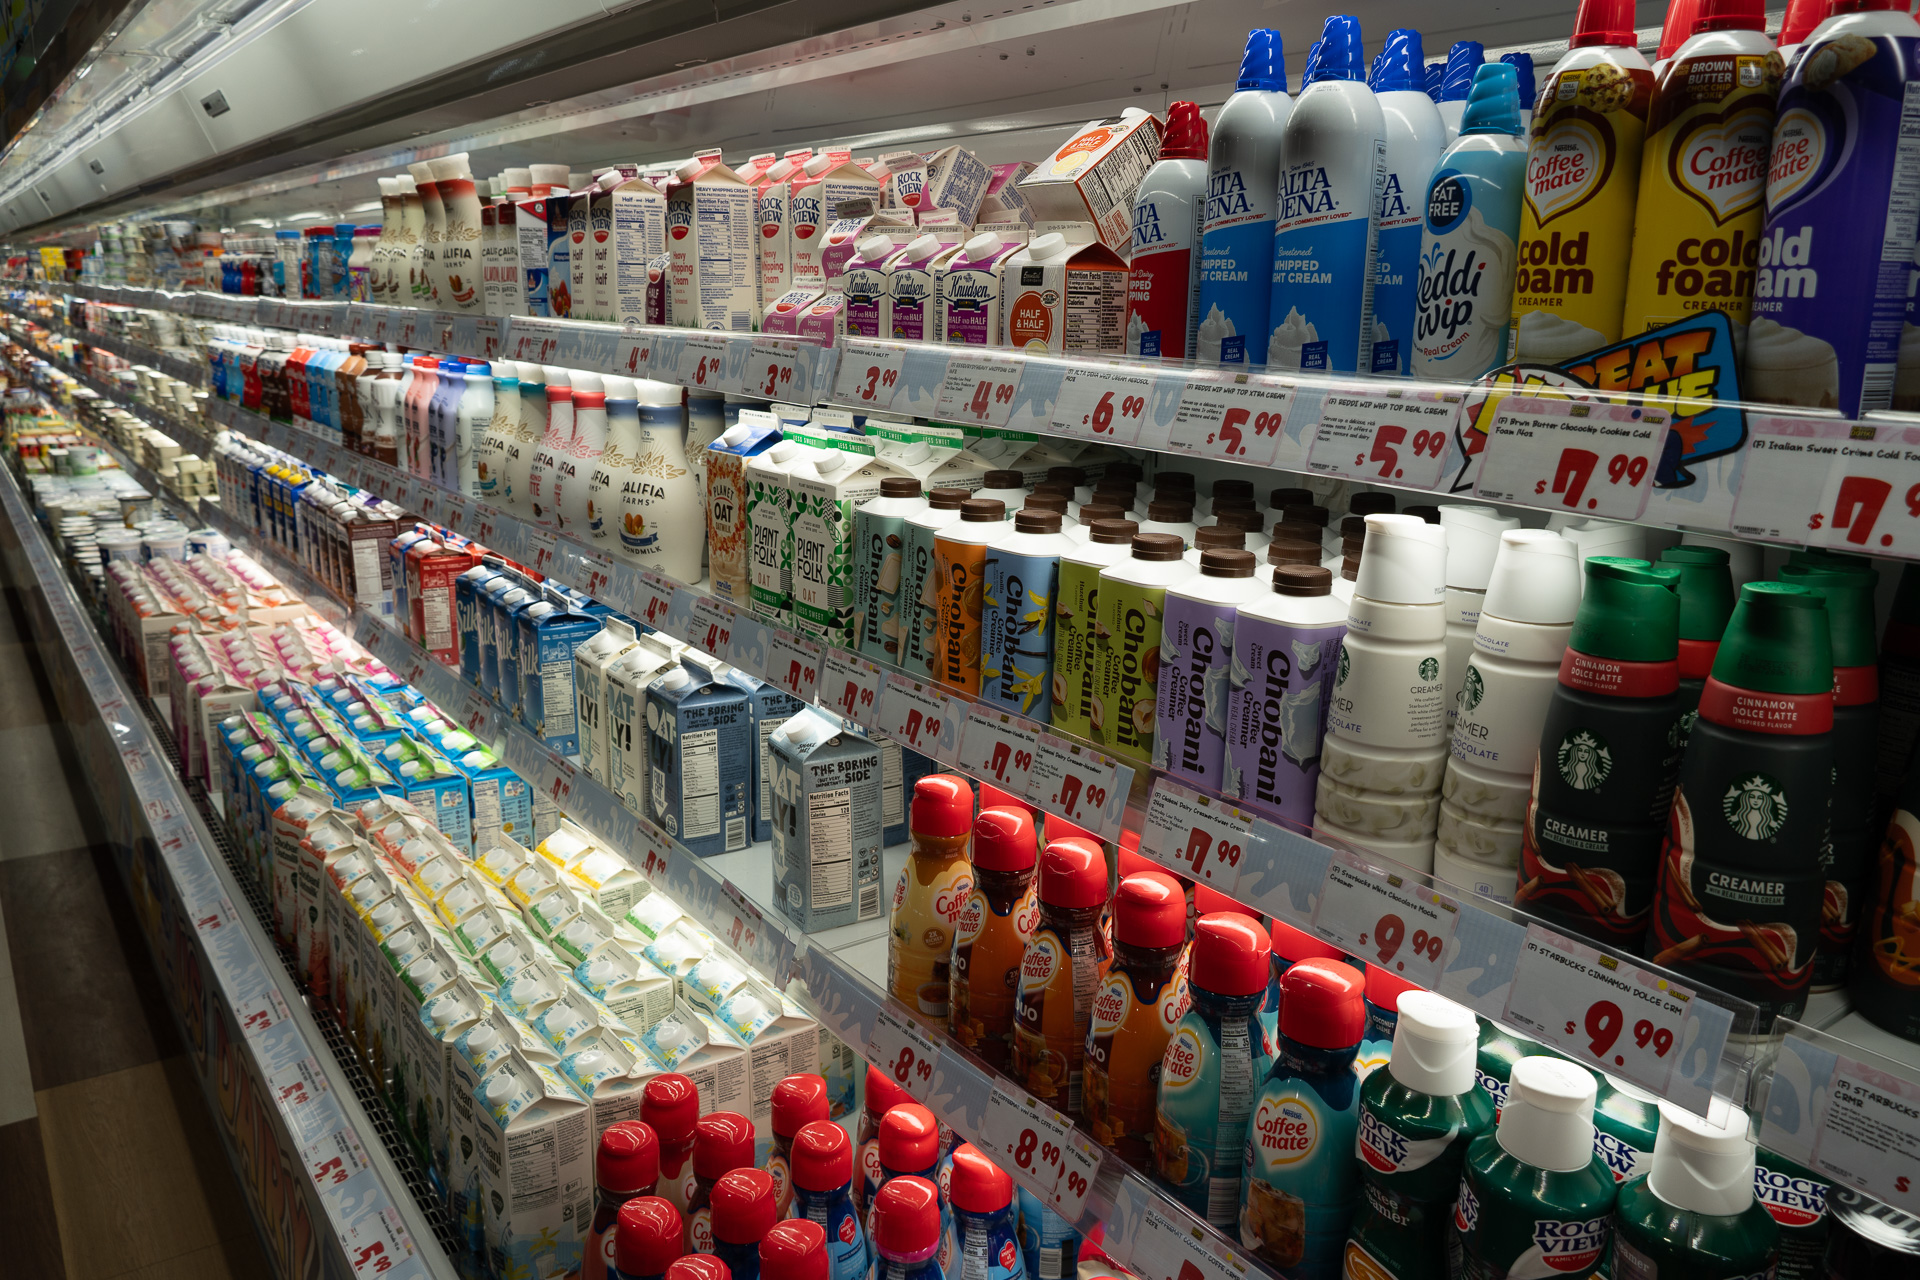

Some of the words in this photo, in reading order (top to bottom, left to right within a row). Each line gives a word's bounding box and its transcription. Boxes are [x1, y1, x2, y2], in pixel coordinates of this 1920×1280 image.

[1691, 61, 1733, 73] BROWN
[1688, 73, 1732, 84] BUTTER
[1687, 85, 1708, 93] CHOC
[1527, 152, 1584, 184] Coffee
[897, 171, 921, 188] ROCK
[1280, 167, 1331, 196] ALTA
[1534, 167, 1585, 196] mate
[898, 183, 922, 195] VIEW
[1433, 187, 1456, 201] FAT
[792, 198, 820, 213] ROCK
[1429, 202, 1459, 217] FREE
[793, 211, 819, 225] VIEW
[595, 248, 607, 261] Half
[673, 252, 686, 261] Heavy
[796, 251, 811, 261] Heavy
[1278, 246, 1312, 256] Sweetened
[1520, 231, 1589, 266] cold
[671, 260, 693, 275] Whipping
[793, 260, 819, 276] Whipping
[1275, 260, 1319, 271] WHIPPED
[595, 273, 607, 285] Half
[673, 275, 688, 286] Cream
[847, 273, 879, 295] Knudsen
[1210, 271, 1248, 281] CREAM
[1288, 272, 1332, 283] CREAM
[893, 273, 925, 296] Knudsen
[949, 273, 987, 298] Knudsen
[1020, 309, 1040, 318] HALF
[1683, 301, 1743, 311] CREAMER
[1017, 320, 1022, 328] &
[1023, 319, 1044, 329] HALF
[1424, 346, 1439, 357] Real
[1440, 331, 1469, 354] Cream
[1266, 392, 1285, 400] CREAM
[1339, 399, 1359, 407] REDDI
[1424, 407, 1448, 416] CREAM
[1496, 427, 1515, 436] Foam
[1517, 429, 1533, 437] 14oz
[1498, 417, 1508, 426] (F)
[1509, 418, 1530, 427] Brwn
[1533, 420, 1558, 430] Butter
[1560, 423, 1598, 435] Chocochip
[1600, 427, 1630, 437] Cookies
[1633, 429, 1651, 439] Cold
[922, 435, 932, 444] LESS
[934, 437, 950, 446] SWEET
[1753, 440, 1765, 449] (F)
[1768, 441, 1802, 451] Italian
[1807, 444, 1837, 455] Sweet
[1877, 450, 1899, 459] Cold
[713, 485, 734, 500] PLANET
[623, 496, 650, 506] FARMS
[714, 502, 732, 523] OAT
[754, 525, 779, 548] PLANT
[797, 537, 825, 560] PLANT
[754, 546, 777, 569] FOLK
[797, 558, 824, 584] FOLK
[716, 579, 731, 591] vanilla
[757, 572, 770, 587] OAT
[802, 588, 816, 604] OAT
[948, 562, 967, 684] Chobani
[1000, 574, 1024, 710] Chobani
[518, 636, 540, 676] Silk
[1103, 646, 1115, 698] Creamer
[1575, 658, 1620, 673] CINNAMON
[1111, 654, 1121, 694] Coffee
[1116, 608, 1146, 748] Chobani
[1571, 667, 1596, 679] DOLCE
[1599, 672, 1623, 683] LATTE
[1168, 666, 1180, 722] Creamer
[1177, 674, 1188, 717] Coffee
[1410, 684, 1443, 694] CREAMER
[1181, 626, 1213, 774] Chobani
[1736, 696, 1795, 710] CINNAMON
[683, 708, 705, 718] THE
[707, 703, 744, 715] BORING
[1732, 706, 1765, 719] DOLCE
[1768, 709, 1798, 722] LATTE
[713, 714, 736, 726] SIDE
[1240, 690, 1254, 749] Creamer
[1735, 718, 1765, 728] INSPIRED
[1767, 720, 1793, 729] FLAVOR
[1256, 650, 1290, 806] Chobani
[810, 763, 835, 777] THE
[837, 756, 878, 773] BORING
[845, 769, 871, 784] SIDE
[810, 792, 834, 801] Nutrition
[834, 789, 849, 798] Facts
[1544, 818, 1608, 844] CREAMER
[1330, 874, 1353, 889] Creamer
[1708, 872, 1786, 896] CREAMER
[1342, 870, 1371, 889] Starbucks
[1372, 884, 1386, 895] White
[1388, 892, 1417, 910] Chocolate
[1418, 905, 1437, 920] Mocha
[1023, 964, 1050, 977] mate
[1528, 942, 1537, 951] (F)
[1539, 948, 1586, 972] STARBUCKS
[1588, 969, 1631, 992] CINNAMON
[1633, 988, 1661, 1007] DOLCE
[1663, 1001, 1682, 1016] CRM
[1015, 998, 1037, 1022] DUO
[1372, 1014, 1394, 1028] COCONUT
[1834, 1090, 1864, 1109] CRMR
[1837, 1079, 1851, 1091] (F)
[1854, 1087, 1919, 1119] STARBUCKS
[1256, 1107, 1307, 1135] Coffee
[1360, 1106, 1410, 1153] ROCK
[509, 1150, 531, 1159] Calories
[543, 1140, 555, 1149] 130
[1261, 1134, 1308, 1150] mate
[1359, 1123, 1407, 1166] VIEW
[1755, 1167, 1830, 1199] ROCK
[1754, 1184, 1827, 1215] VIEW
